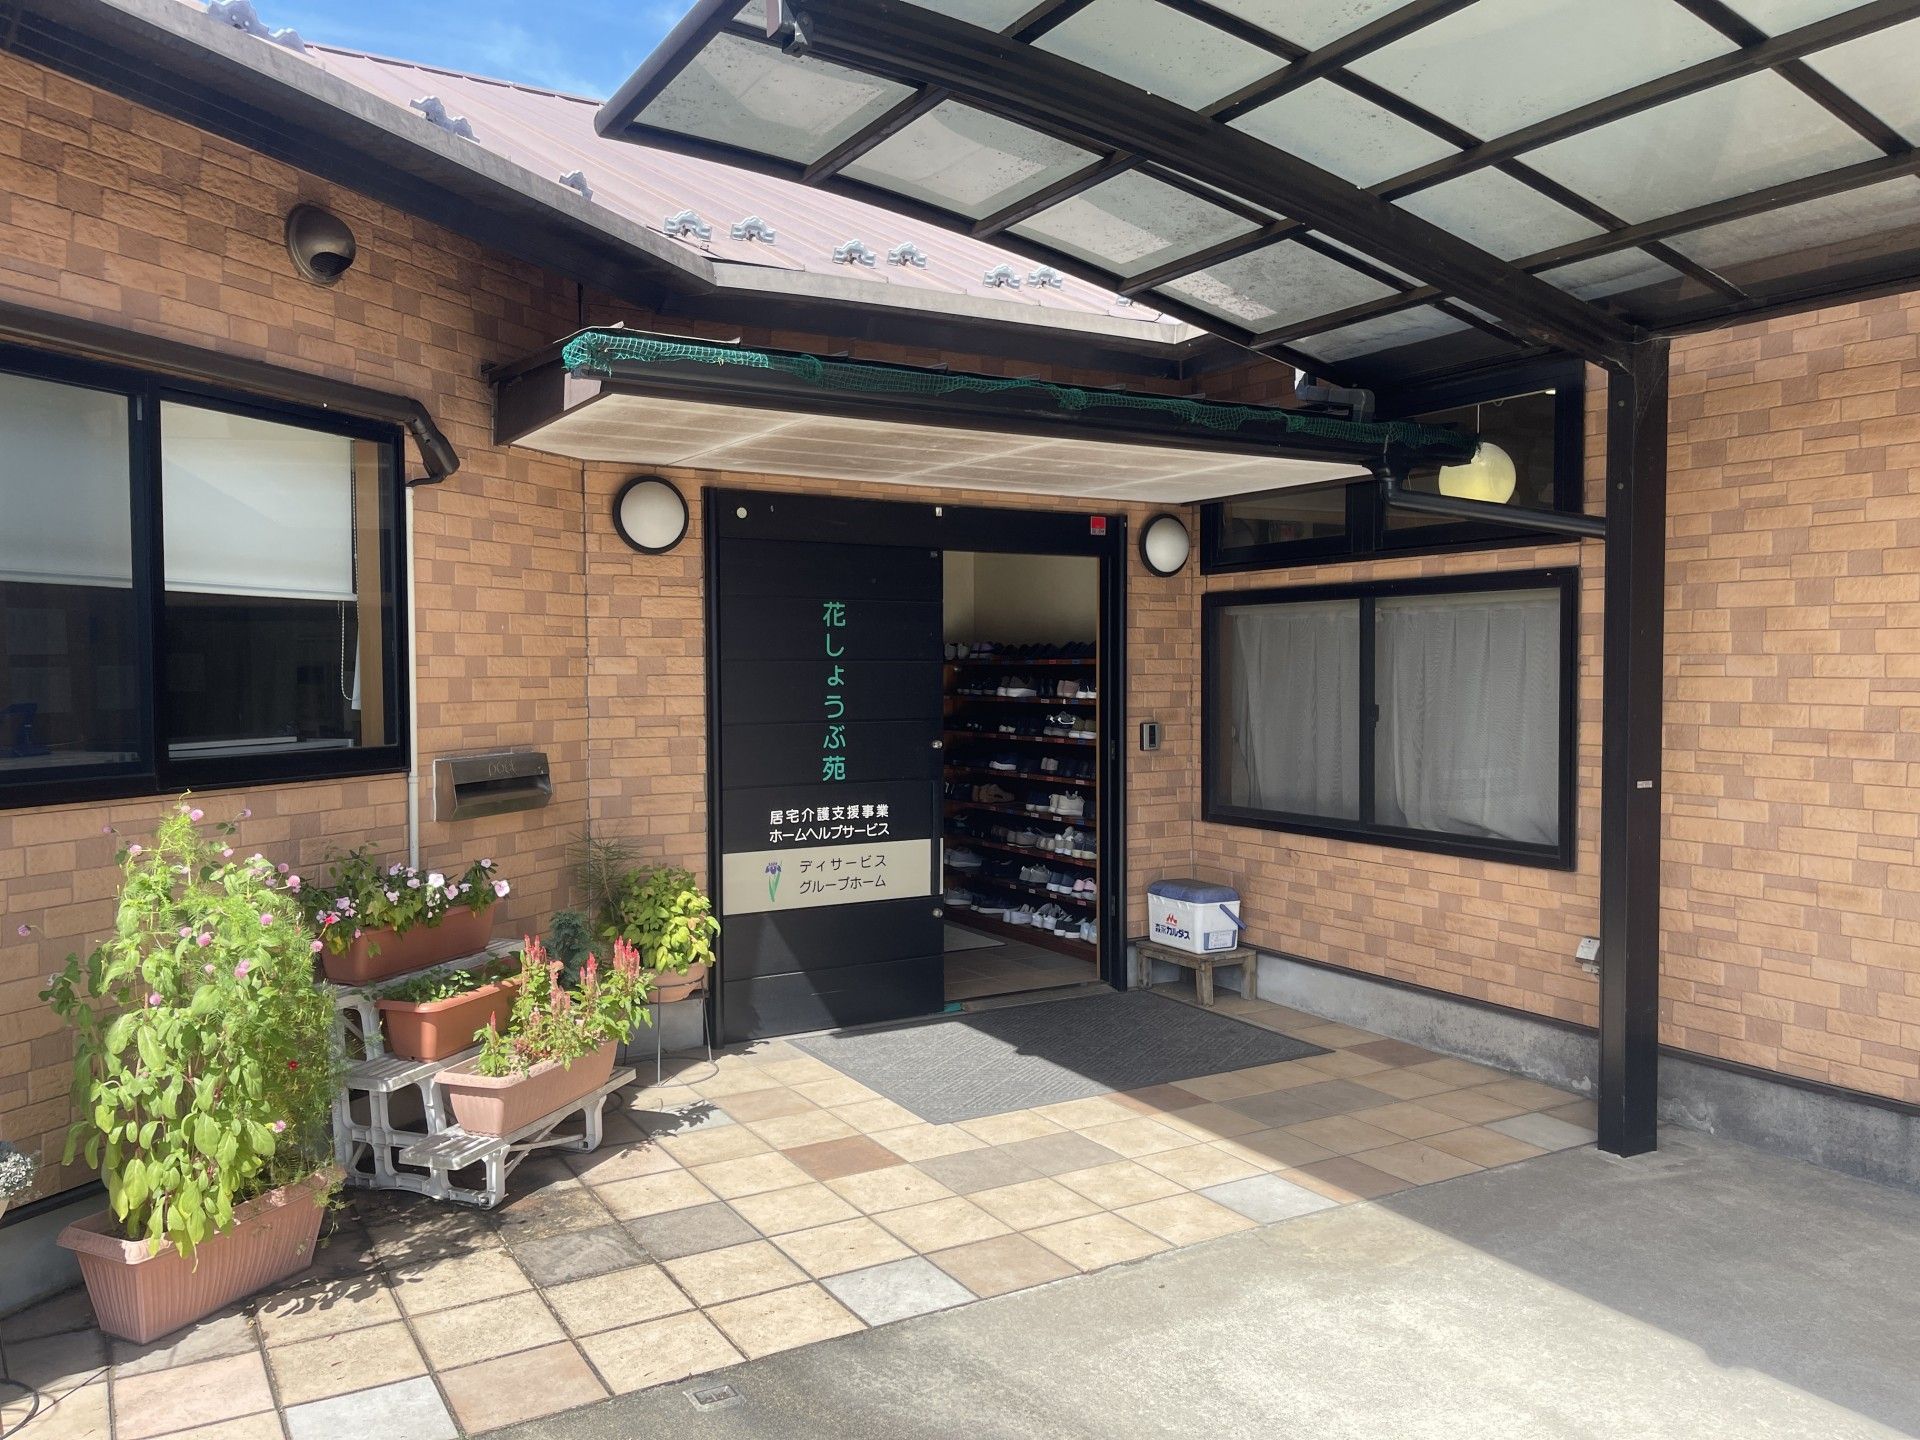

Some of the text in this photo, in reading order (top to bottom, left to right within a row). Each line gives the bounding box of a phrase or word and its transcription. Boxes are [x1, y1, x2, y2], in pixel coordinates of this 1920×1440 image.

[822, 602, 846, 782] 花しょうぶ苑
[769, 803, 889, 825] 居宅介護支援事業
[769, 822, 890, 843] ホームヘルプサービス
[799, 874, 886, 895] グループホーム
